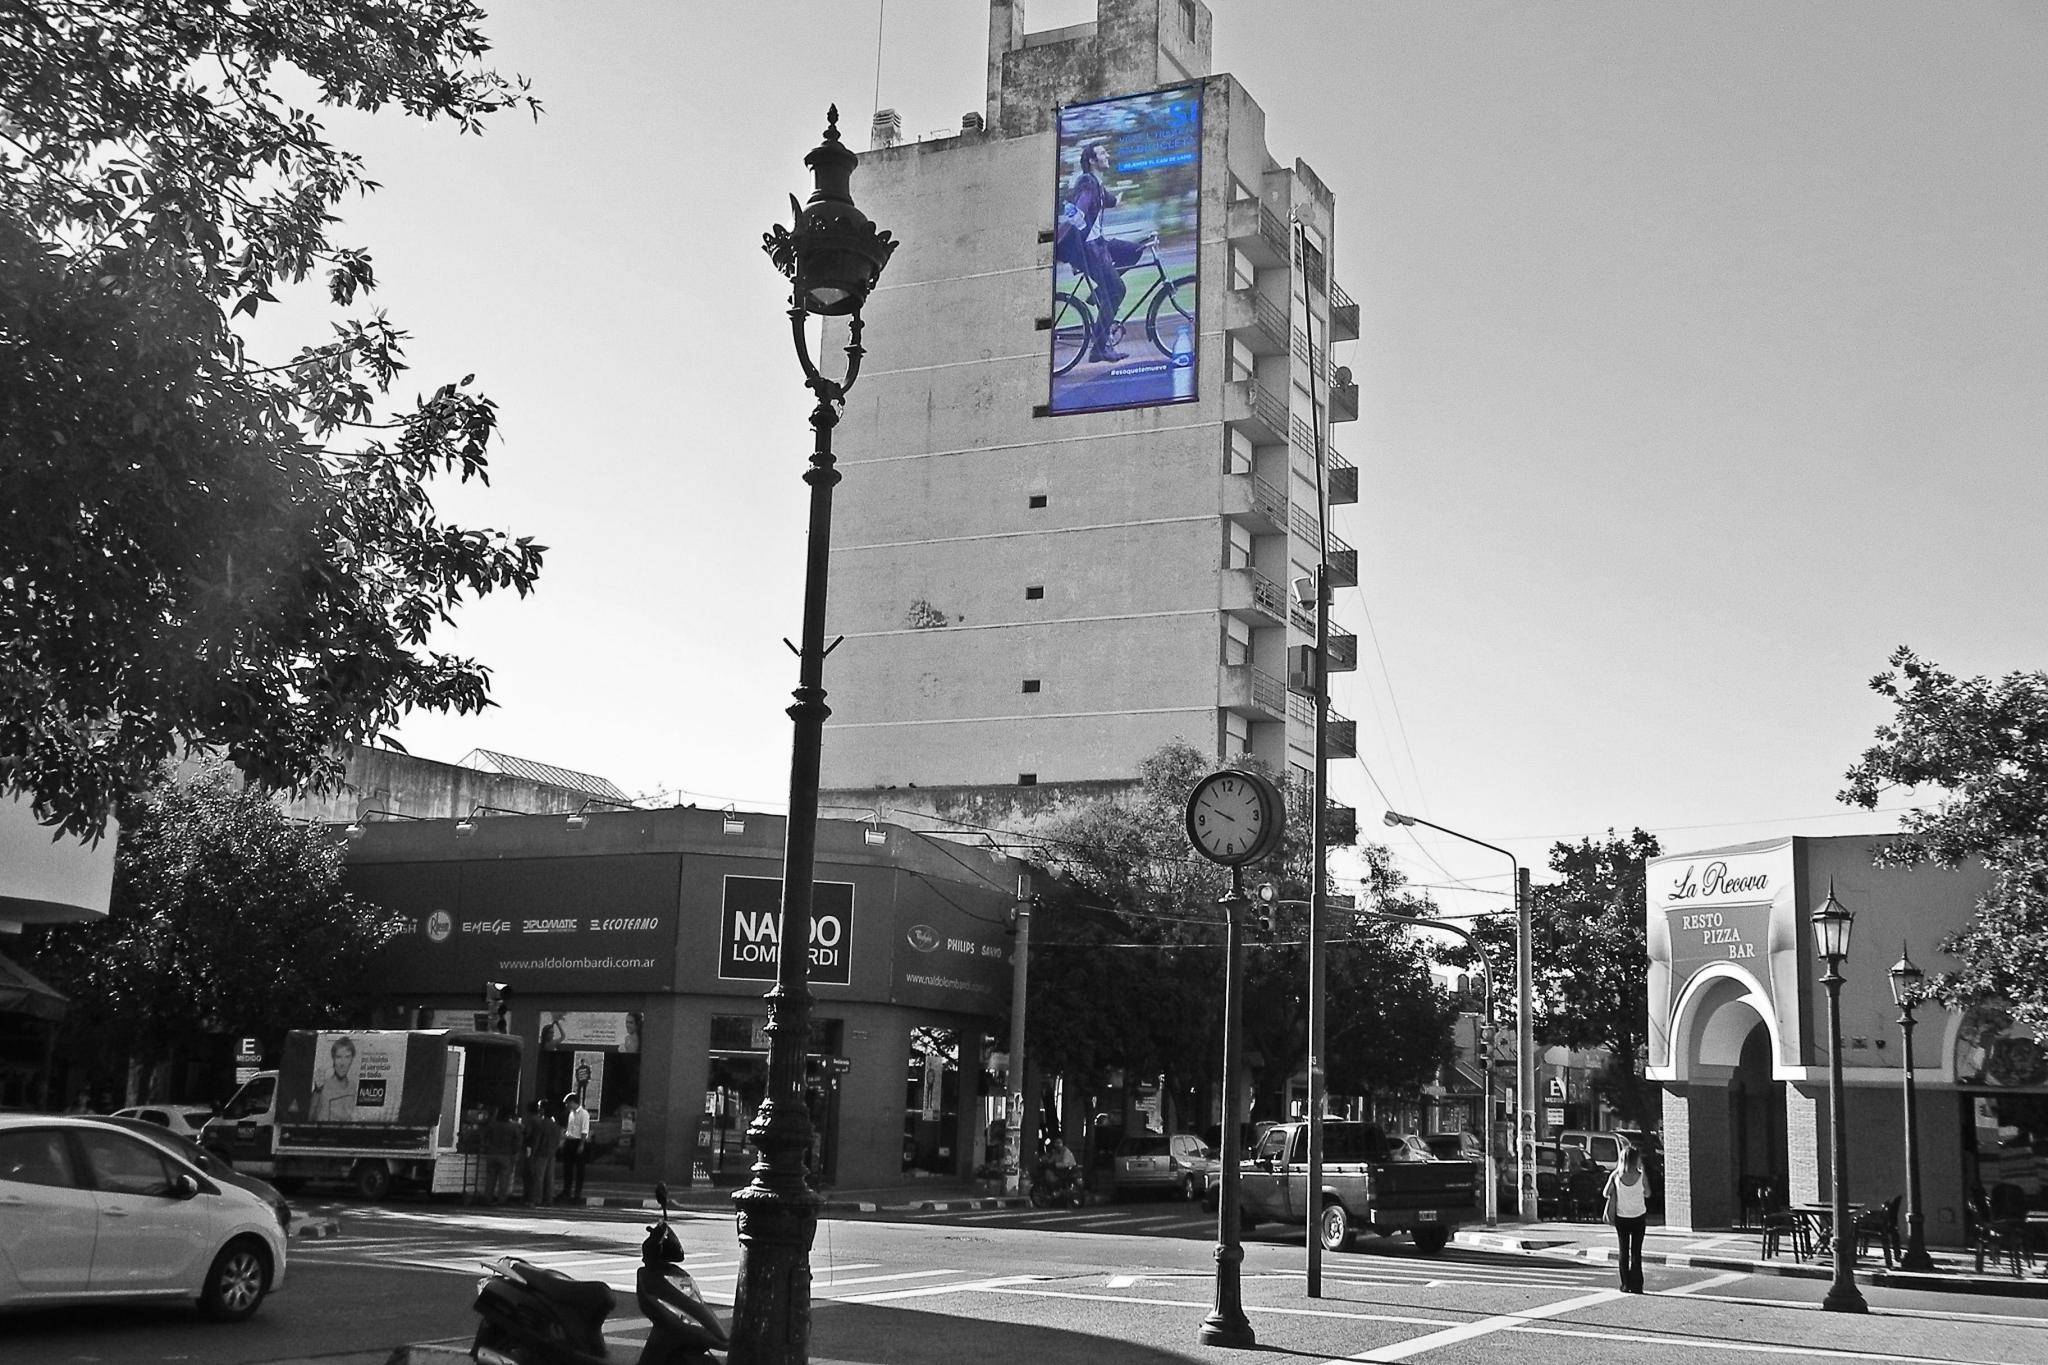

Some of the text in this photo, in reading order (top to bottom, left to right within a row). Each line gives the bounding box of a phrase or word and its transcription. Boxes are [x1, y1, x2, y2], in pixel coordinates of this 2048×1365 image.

[1222, 781, 1233, 792] 12
[1199, 815, 1206, 826] 9
[1253, 810, 1260, 821] 3
[1227, 843, 1234, 854] 6
[1668, 861, 1769, 901] La Recova
[462, 919, 511, 936] EMEGE
[523, 919, 577, 929] DIPLOMATIC
[602, 916, 659, 931] ECOTERMO
[734, 910, 841, 947] NAO
[1682, 912, 1723, 930] RESTO
[1703, 928, 1741, 945] PIZZA
[733, 943, 838, 966] LOMRDI
[947, 938, 975, 955] PHILIPS
[1728, 943, 1756, 959] BAR
[499, 956, 655, 970] www.naldolombardi.com.ar
[242, 1038, 256, 1054] E
[360, 1088, 384, 1097] NALDO
[1550, 1079, 1562, 1096] E
